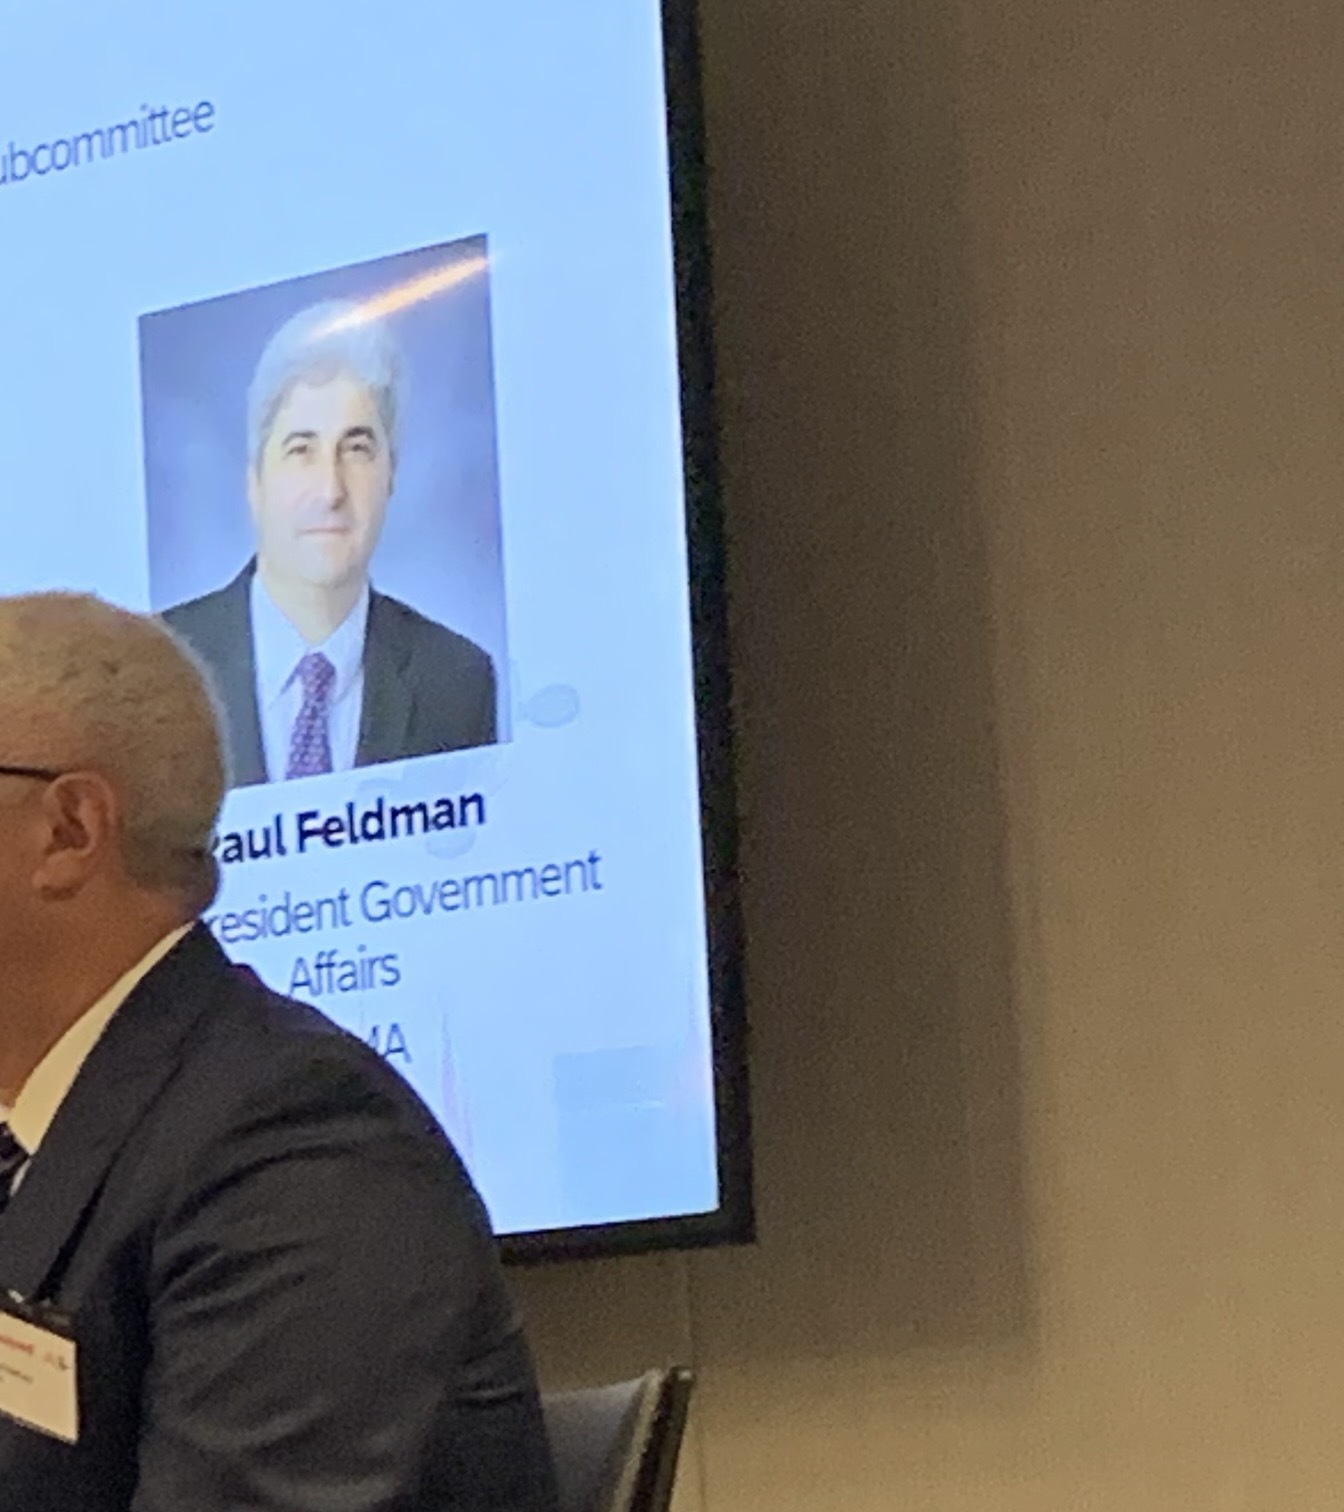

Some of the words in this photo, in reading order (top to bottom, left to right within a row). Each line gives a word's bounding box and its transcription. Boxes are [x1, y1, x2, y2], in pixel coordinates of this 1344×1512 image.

[212, 812, 287, 864] aul
[297, 791, 486, 853] Feldman
[361, 849, 603, 922] Government
[289, 944, 401, 997] Affairs
